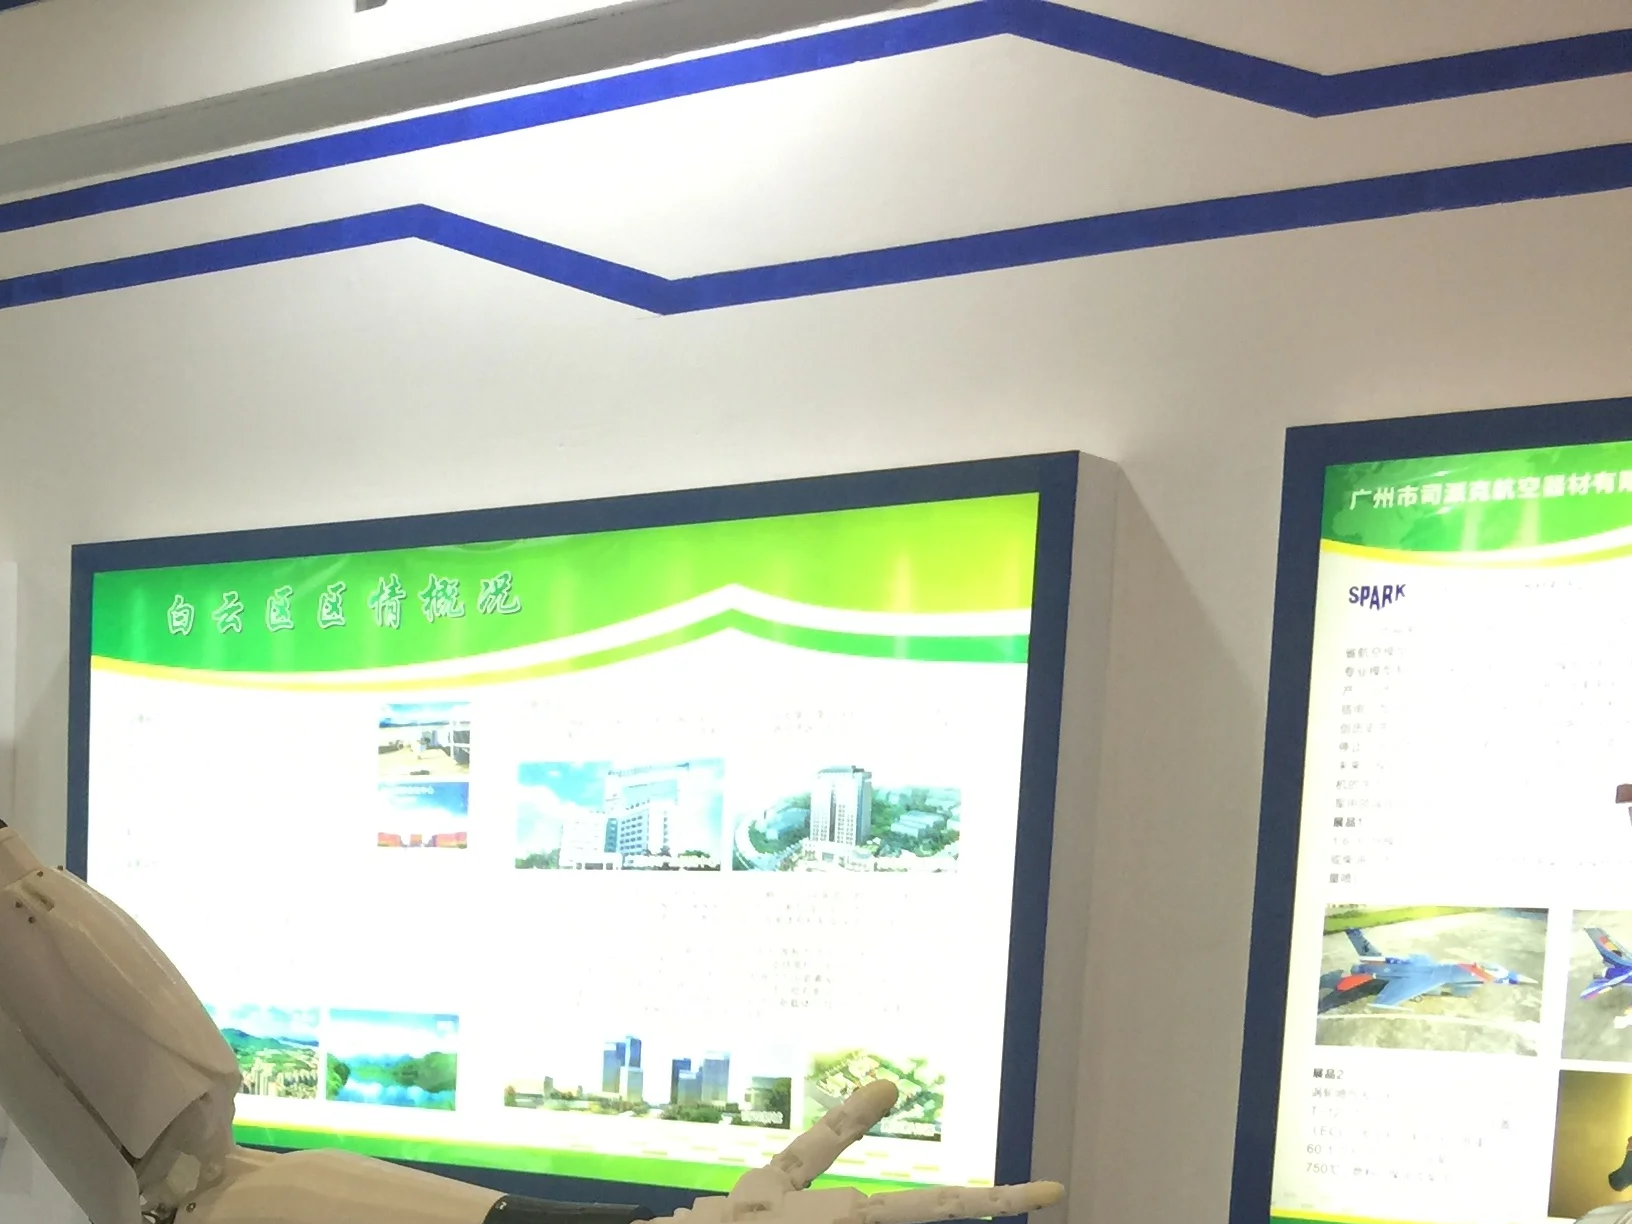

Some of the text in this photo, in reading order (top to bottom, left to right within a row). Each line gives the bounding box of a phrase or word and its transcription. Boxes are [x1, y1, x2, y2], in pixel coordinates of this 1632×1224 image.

[167, 571, 522, 635] 白云区区情概况
[1348, 583, 1406, 611] SPARK
